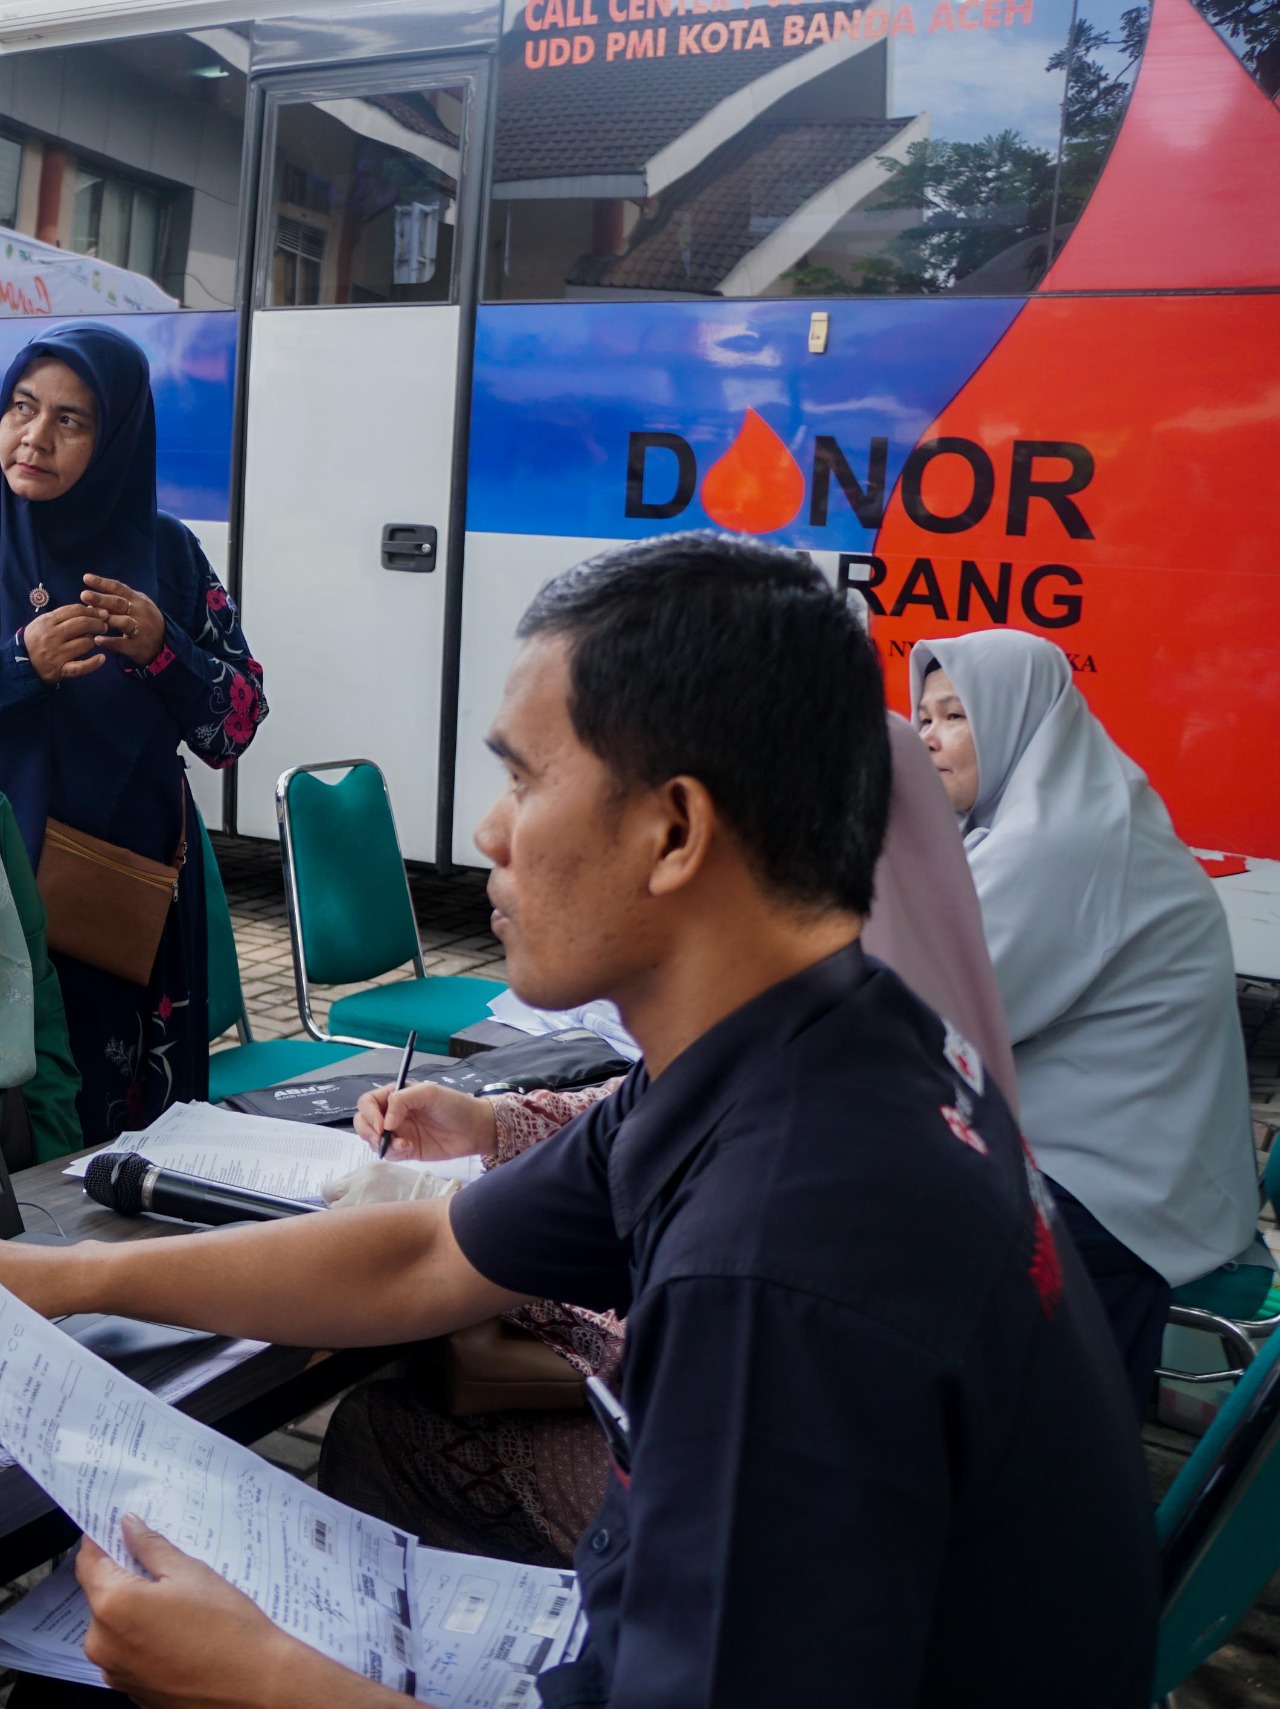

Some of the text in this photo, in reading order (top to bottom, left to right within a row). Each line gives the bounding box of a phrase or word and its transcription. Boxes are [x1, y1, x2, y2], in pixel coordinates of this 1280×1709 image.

[525, 0, 598, 31] CALL
[525, 0, 1035, 70] UDD PMI KOTA BANDA ACEH
